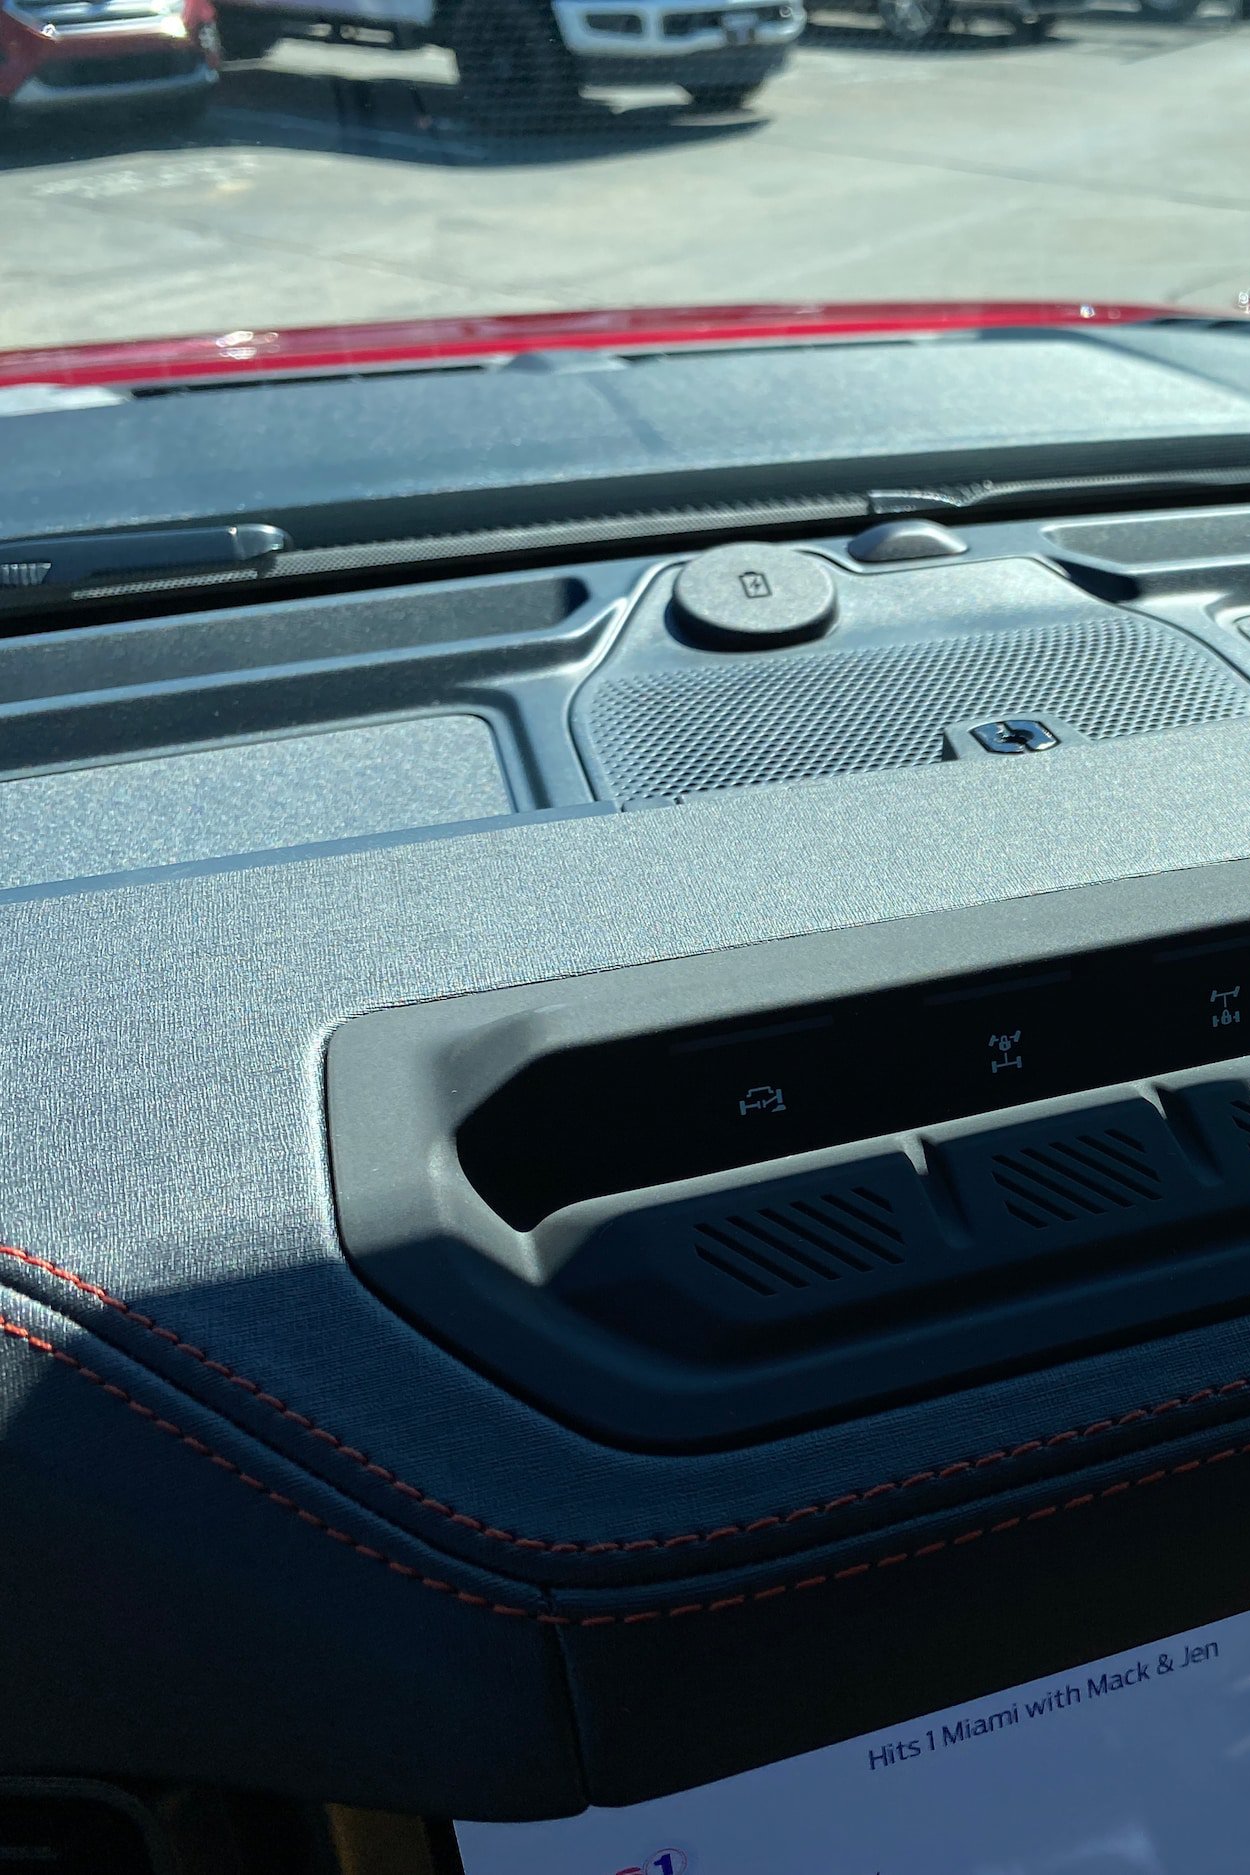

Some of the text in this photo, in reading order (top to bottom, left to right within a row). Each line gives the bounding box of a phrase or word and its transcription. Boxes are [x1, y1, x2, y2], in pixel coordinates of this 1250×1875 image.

[868, 1641, 1220, 1770] Hits 1 Miami with Mack & Jen
